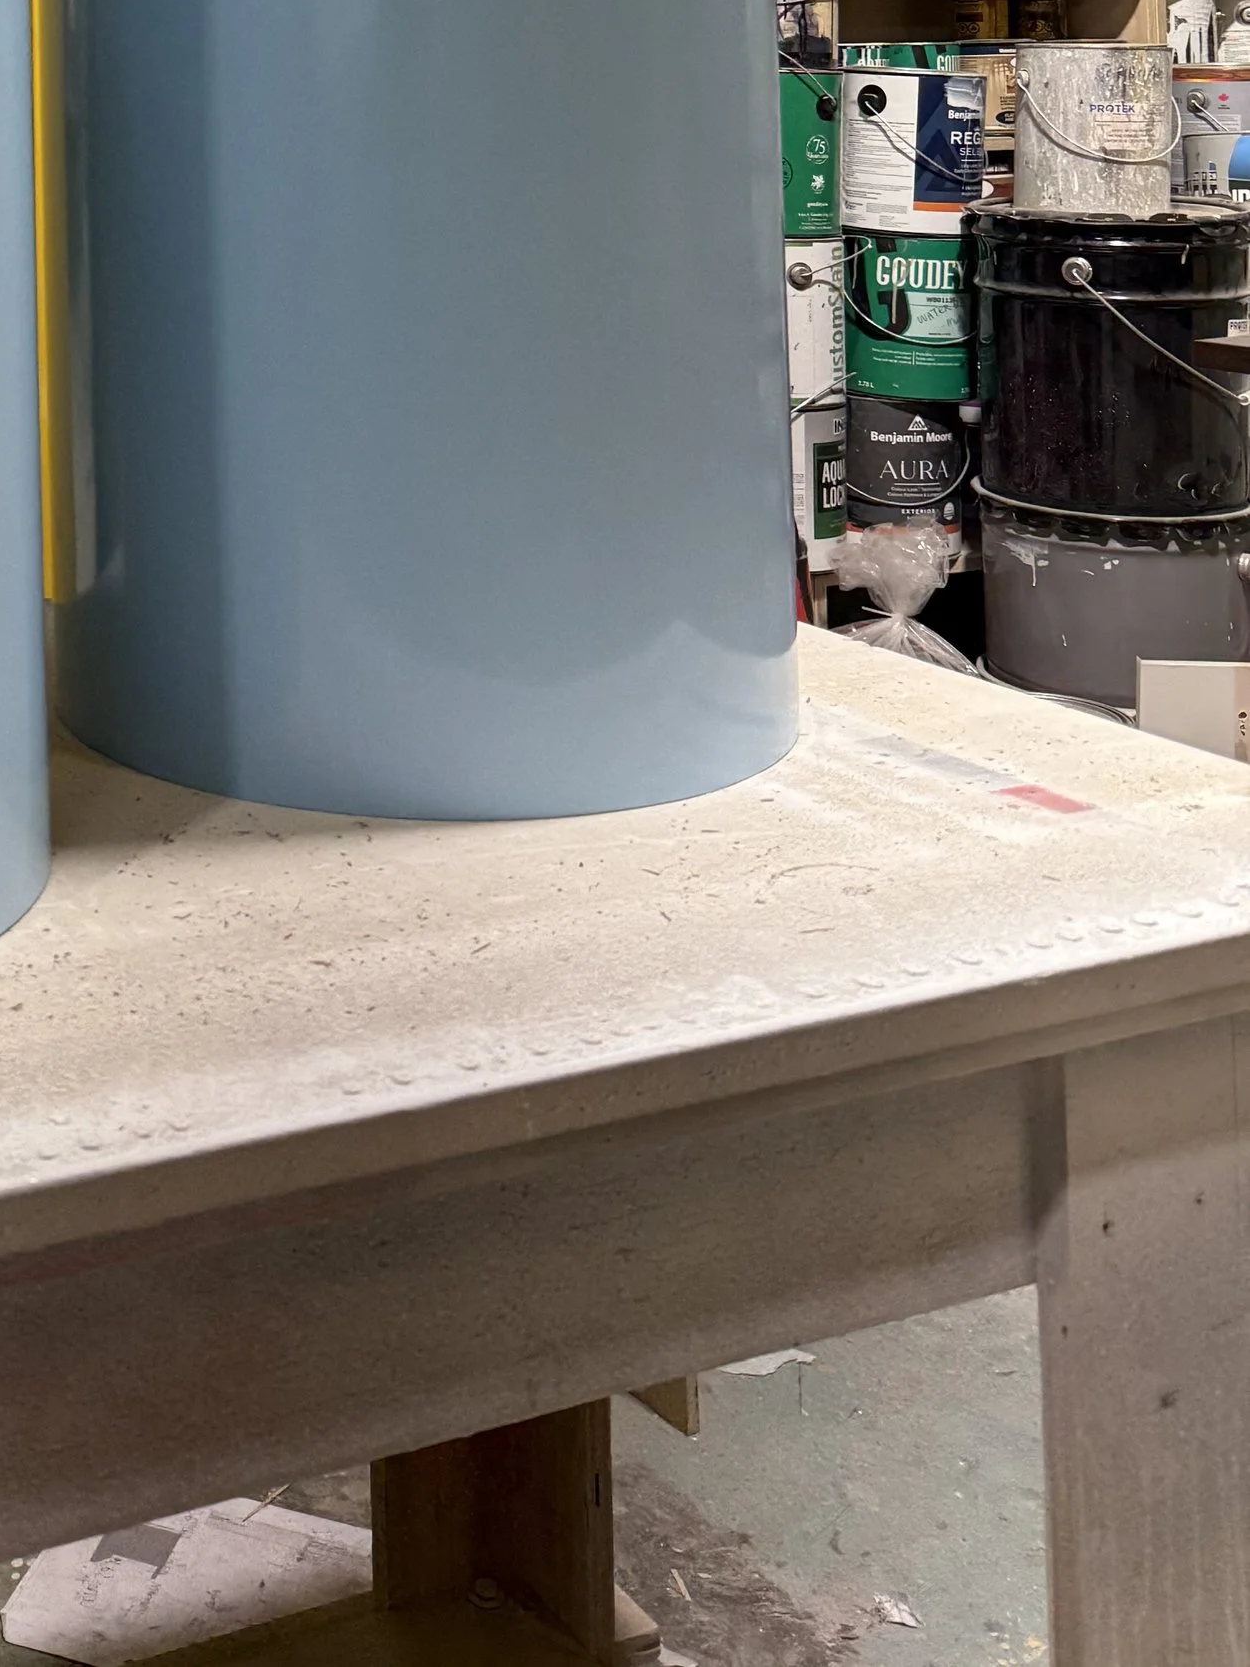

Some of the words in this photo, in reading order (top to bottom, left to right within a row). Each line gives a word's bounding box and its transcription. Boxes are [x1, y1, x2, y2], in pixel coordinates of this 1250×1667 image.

[1090, 104, 1136, 113] PROTEK
[876, 255, 968, 290] GOUDEY
[870, 431, 923, 444] Benjamin
[926, 432, 952, 443] Moore
[879, 460, 949, 480] AURA
